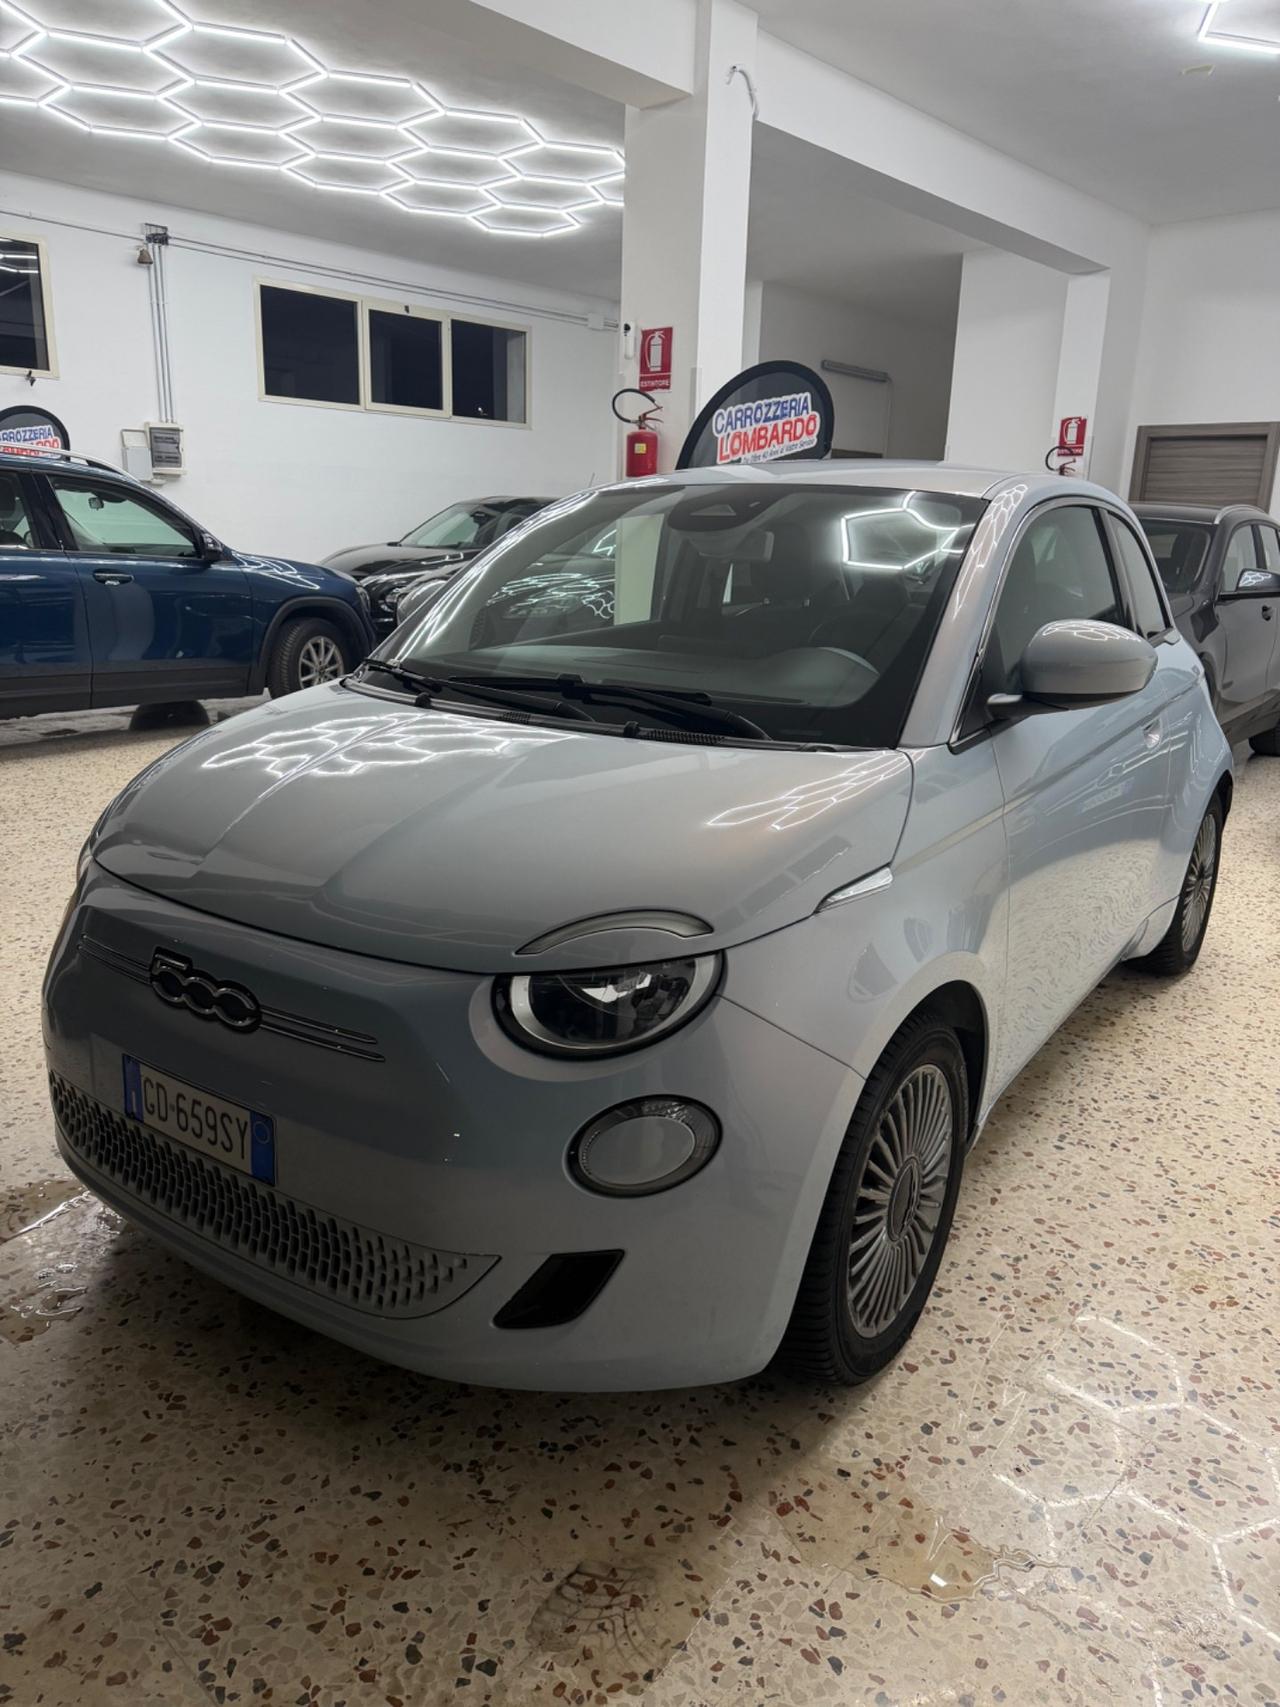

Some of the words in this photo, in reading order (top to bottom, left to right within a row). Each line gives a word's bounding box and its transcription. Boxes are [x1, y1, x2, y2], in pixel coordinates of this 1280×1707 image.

[0, 426, 53, 443] RROZZERIA
[714, 395, 810, 435] CARROZZERIA
[719, 414, 817, 461] LOMBARDO
[151, 949, 260, 1030] 500
